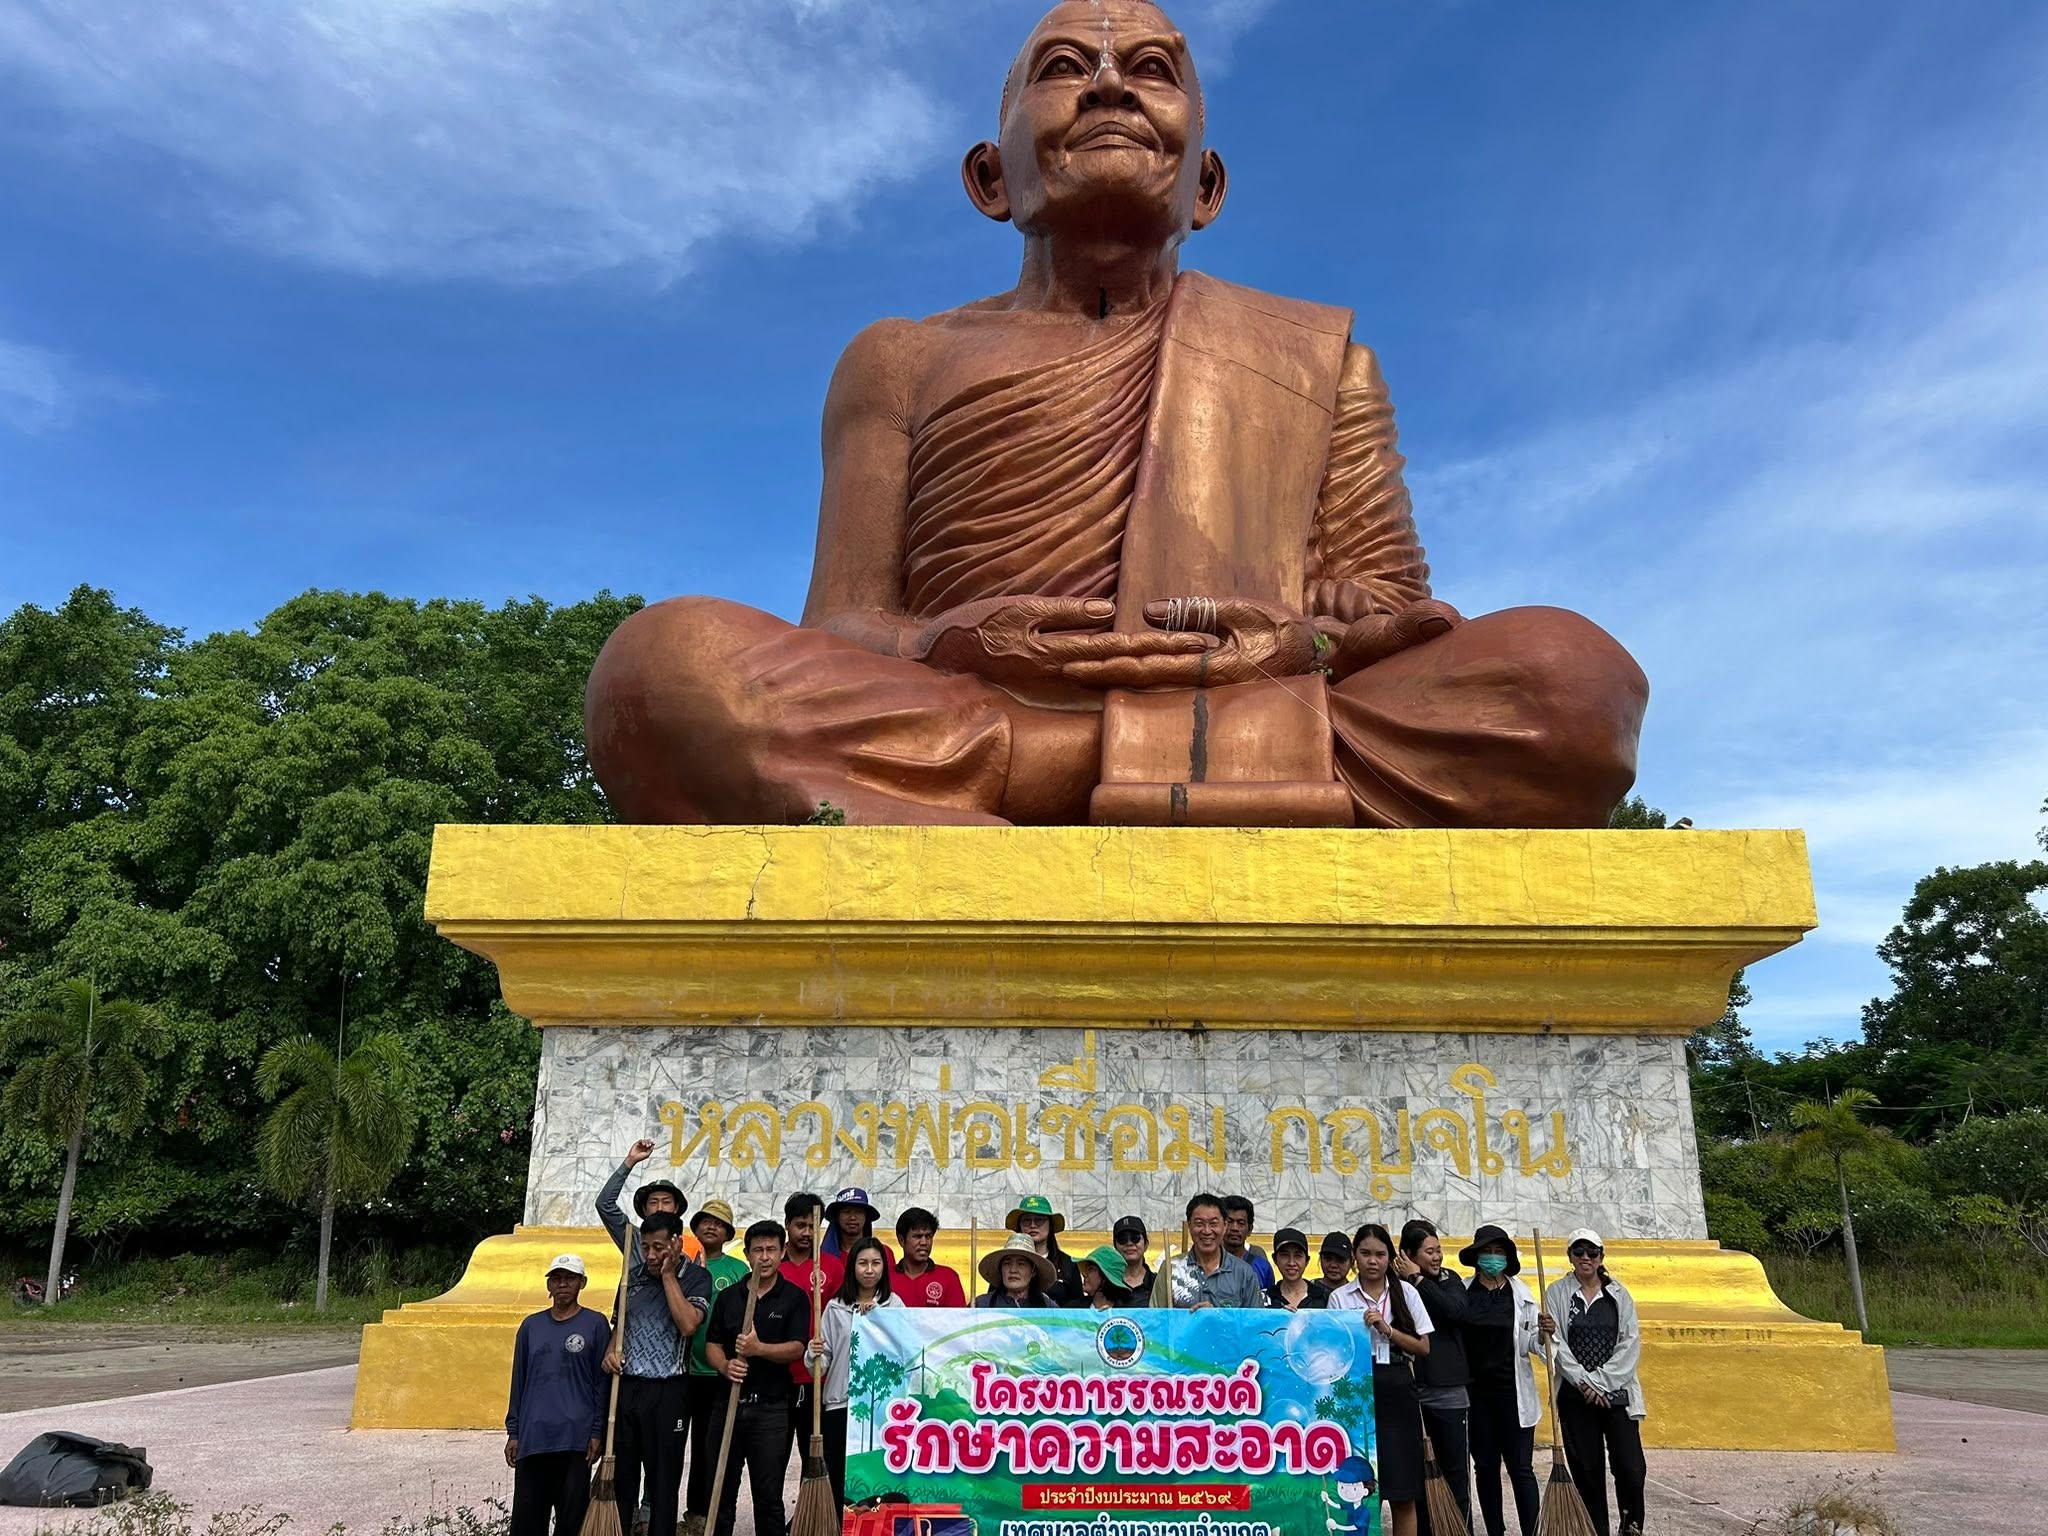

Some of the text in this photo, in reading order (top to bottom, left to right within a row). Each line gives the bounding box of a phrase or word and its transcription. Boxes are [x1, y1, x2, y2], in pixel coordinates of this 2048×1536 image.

[659, 1029, 1227, 1172] หลวงพ่อเชื่อม
[970, 1363, 1258, 1411] โครงการรณรงค์
[883, 1401, 1347, 1469] รักษาความสะอาด
[1039, 1487, 1232, 1505] ประจำปีงบประมาณ ๒๕๖๙
